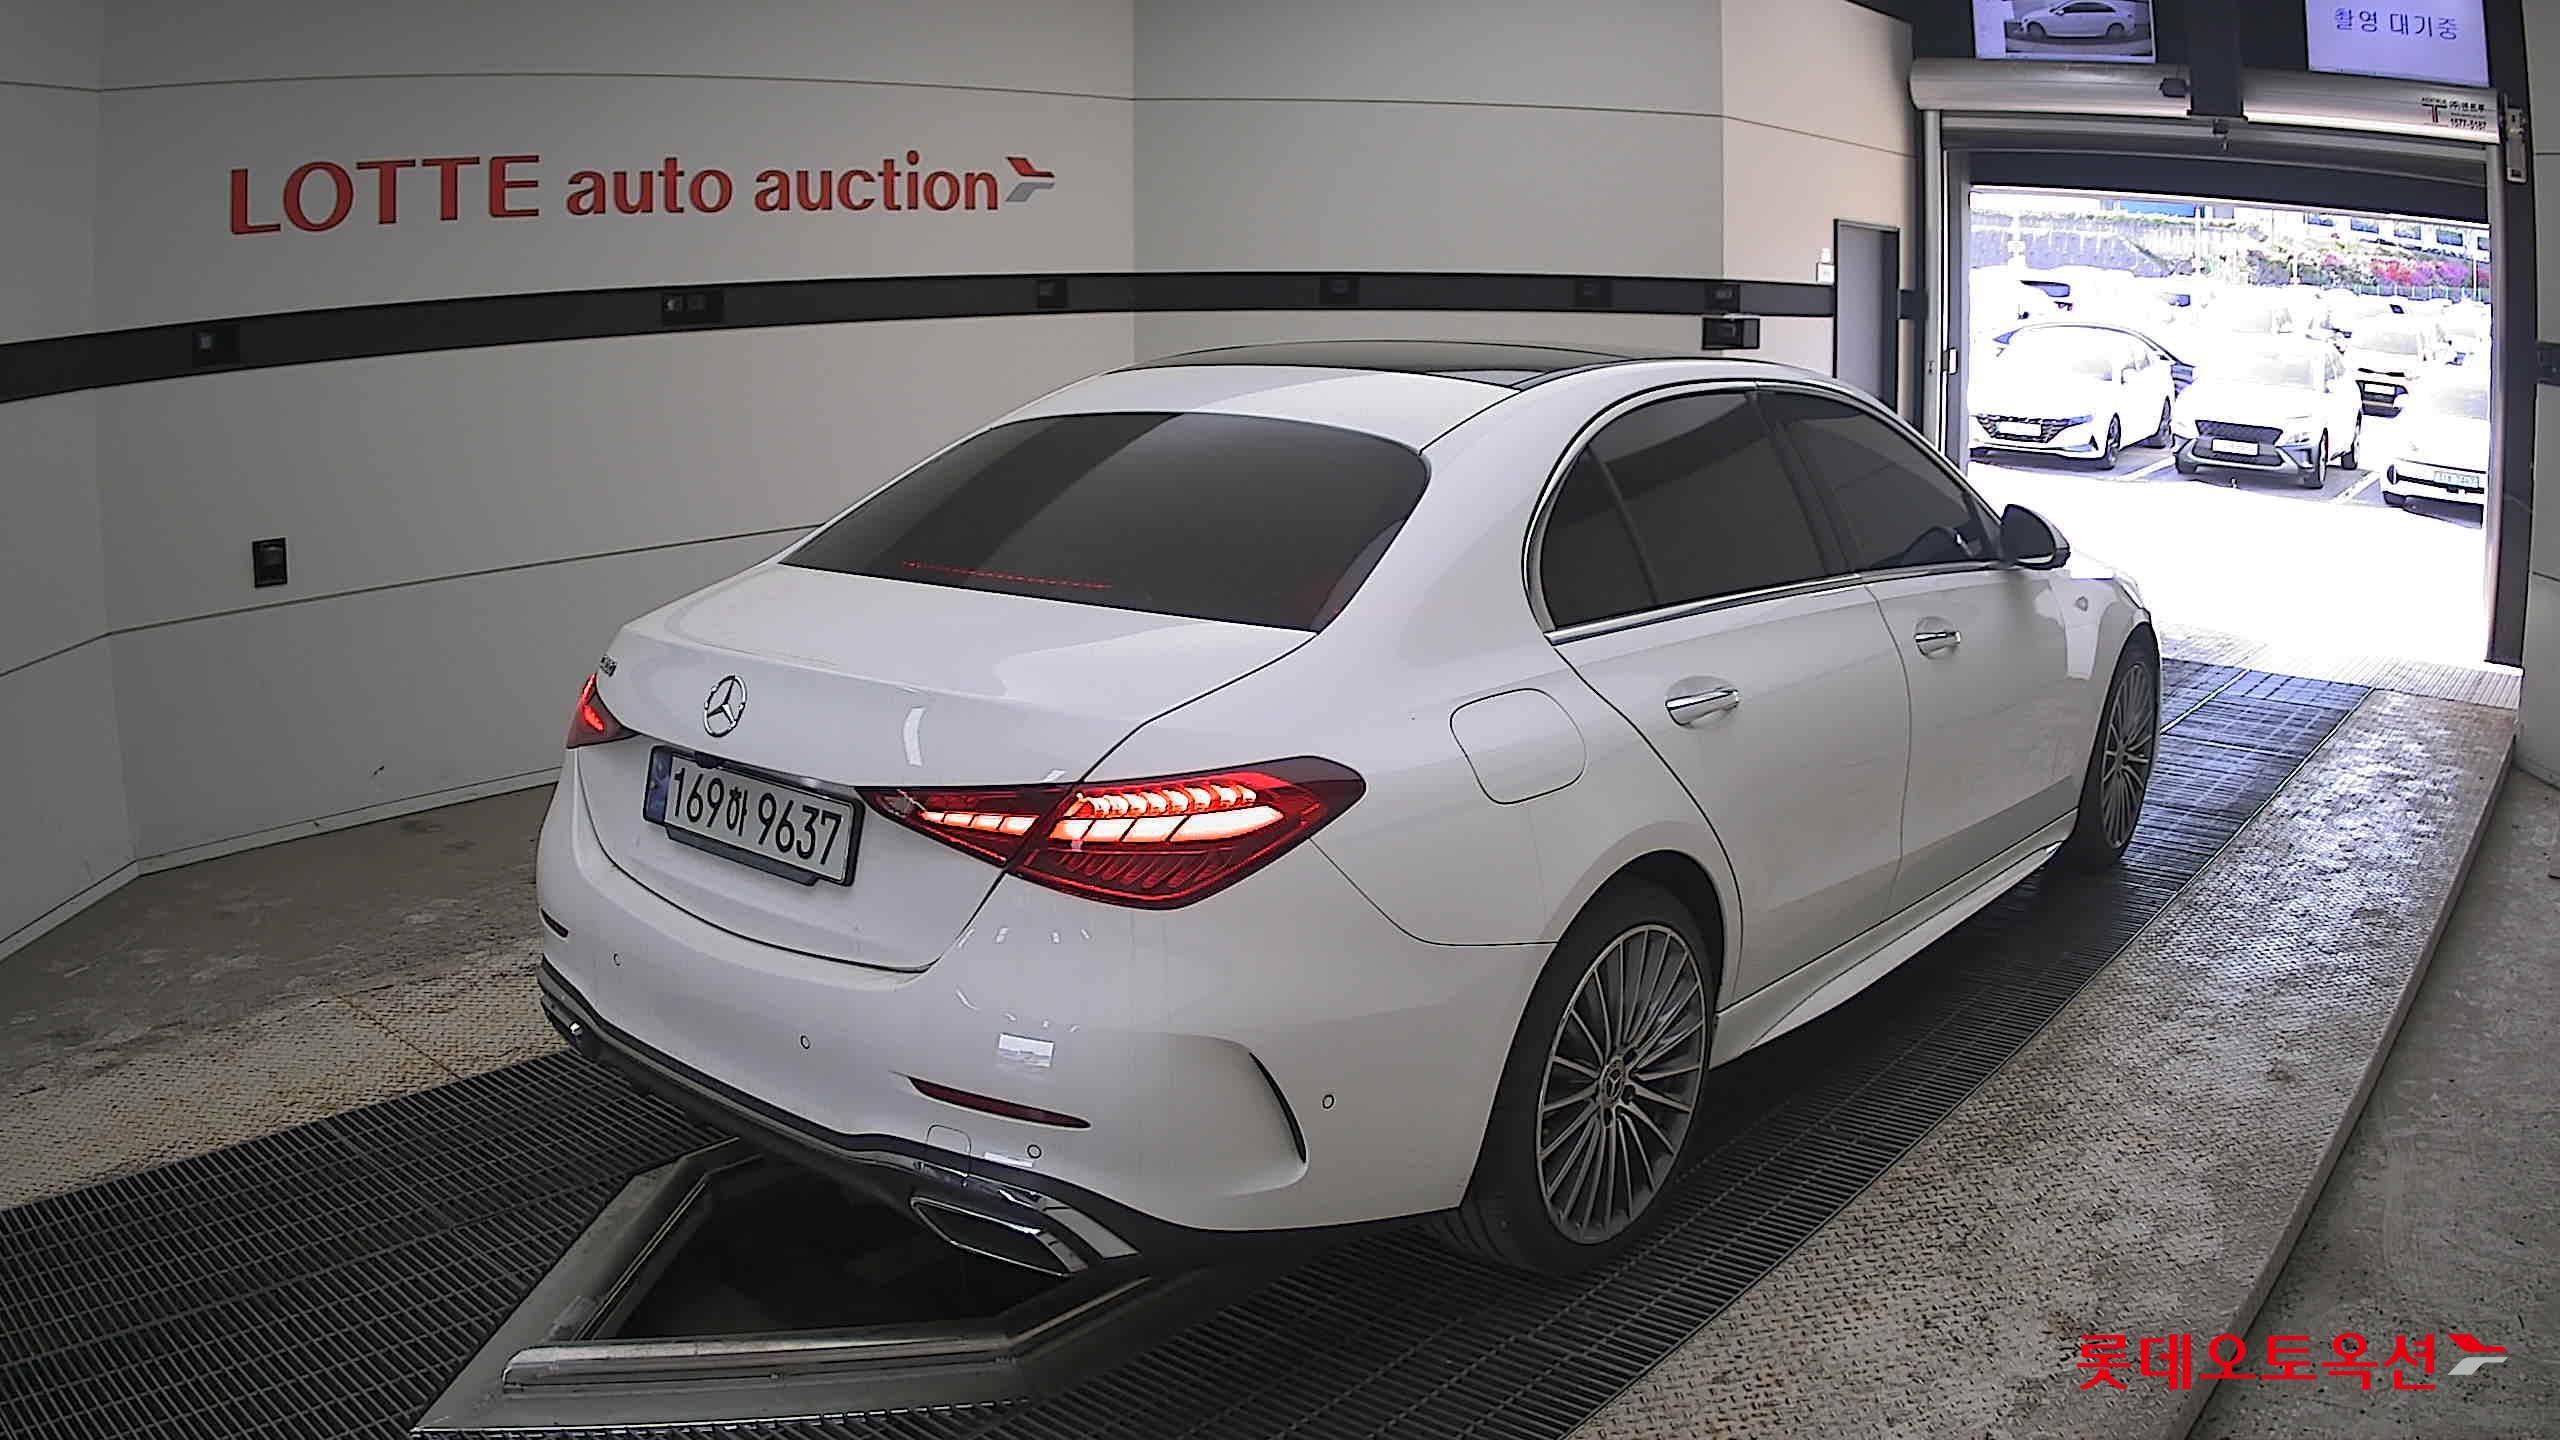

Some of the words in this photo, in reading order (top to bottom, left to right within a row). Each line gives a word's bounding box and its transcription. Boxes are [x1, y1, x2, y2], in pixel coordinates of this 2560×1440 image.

[2335, 8, 2377, 32] 촬영
[2389, 13, 2457, 40] 대기중
[230, 155, 540, 235] LOTTE
[566, 157, 733, 215] auto
[753, 150, 999, 211] auction
[674, 767, 748, 837] 169하
[757, 792, 843, 865] 9637
